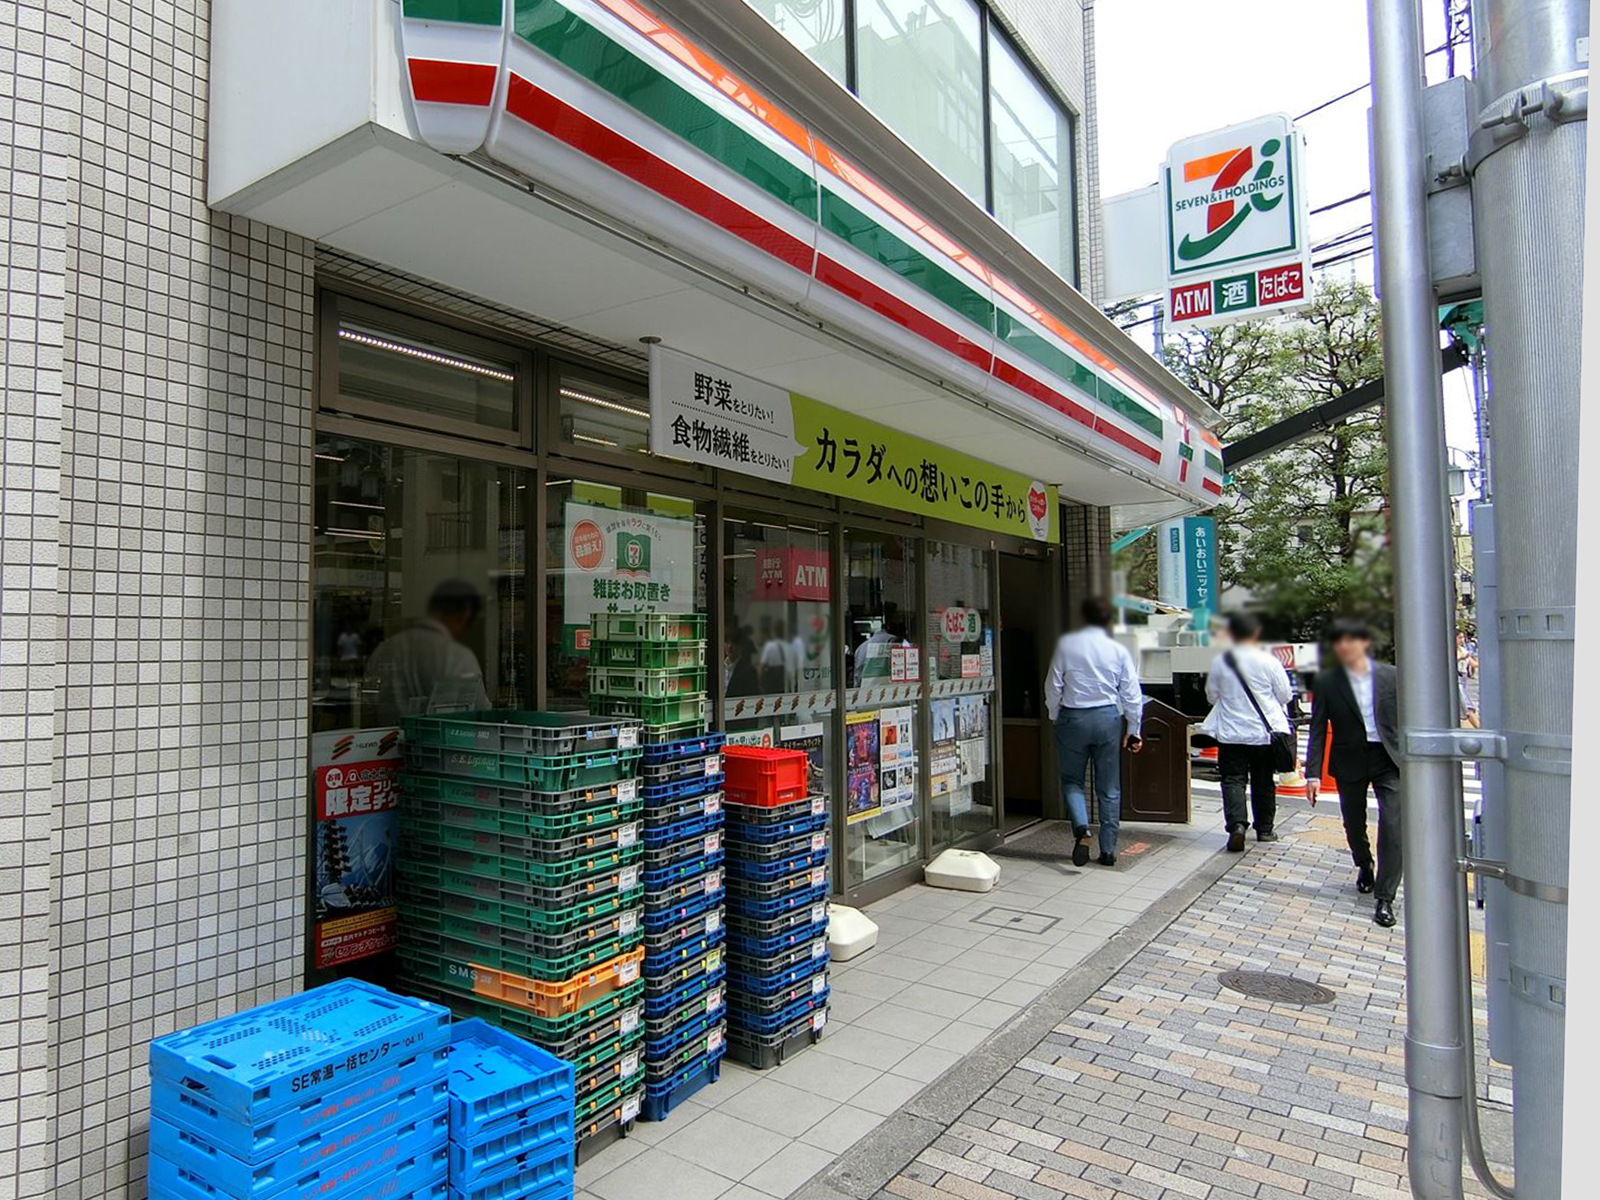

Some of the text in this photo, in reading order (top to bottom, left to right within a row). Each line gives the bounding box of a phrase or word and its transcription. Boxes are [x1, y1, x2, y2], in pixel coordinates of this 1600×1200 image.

[1225, 175, 1286, 200] HOLDINGS
[1221, 279, 1248, 309] 酒
[1259, 271, 1302, 300] たばこ
[1173, 287, 1210, 317] ATM
[815, 427, 1027, 524] カラダへの想いこの手から
[761, 570, 784, 580] ATM
[762, 557, 782, 570] 銀行
[795, 565, 828, 588] ATM
[593, 578, 671, 602] 雑誌お取置き
[945, 612, 965, 633] たばこ
[326, 785, 372, 817] 限定
[448, 963, 484, 981] SMS
[291, 1041, 401, 1094] SE常温一括センター
